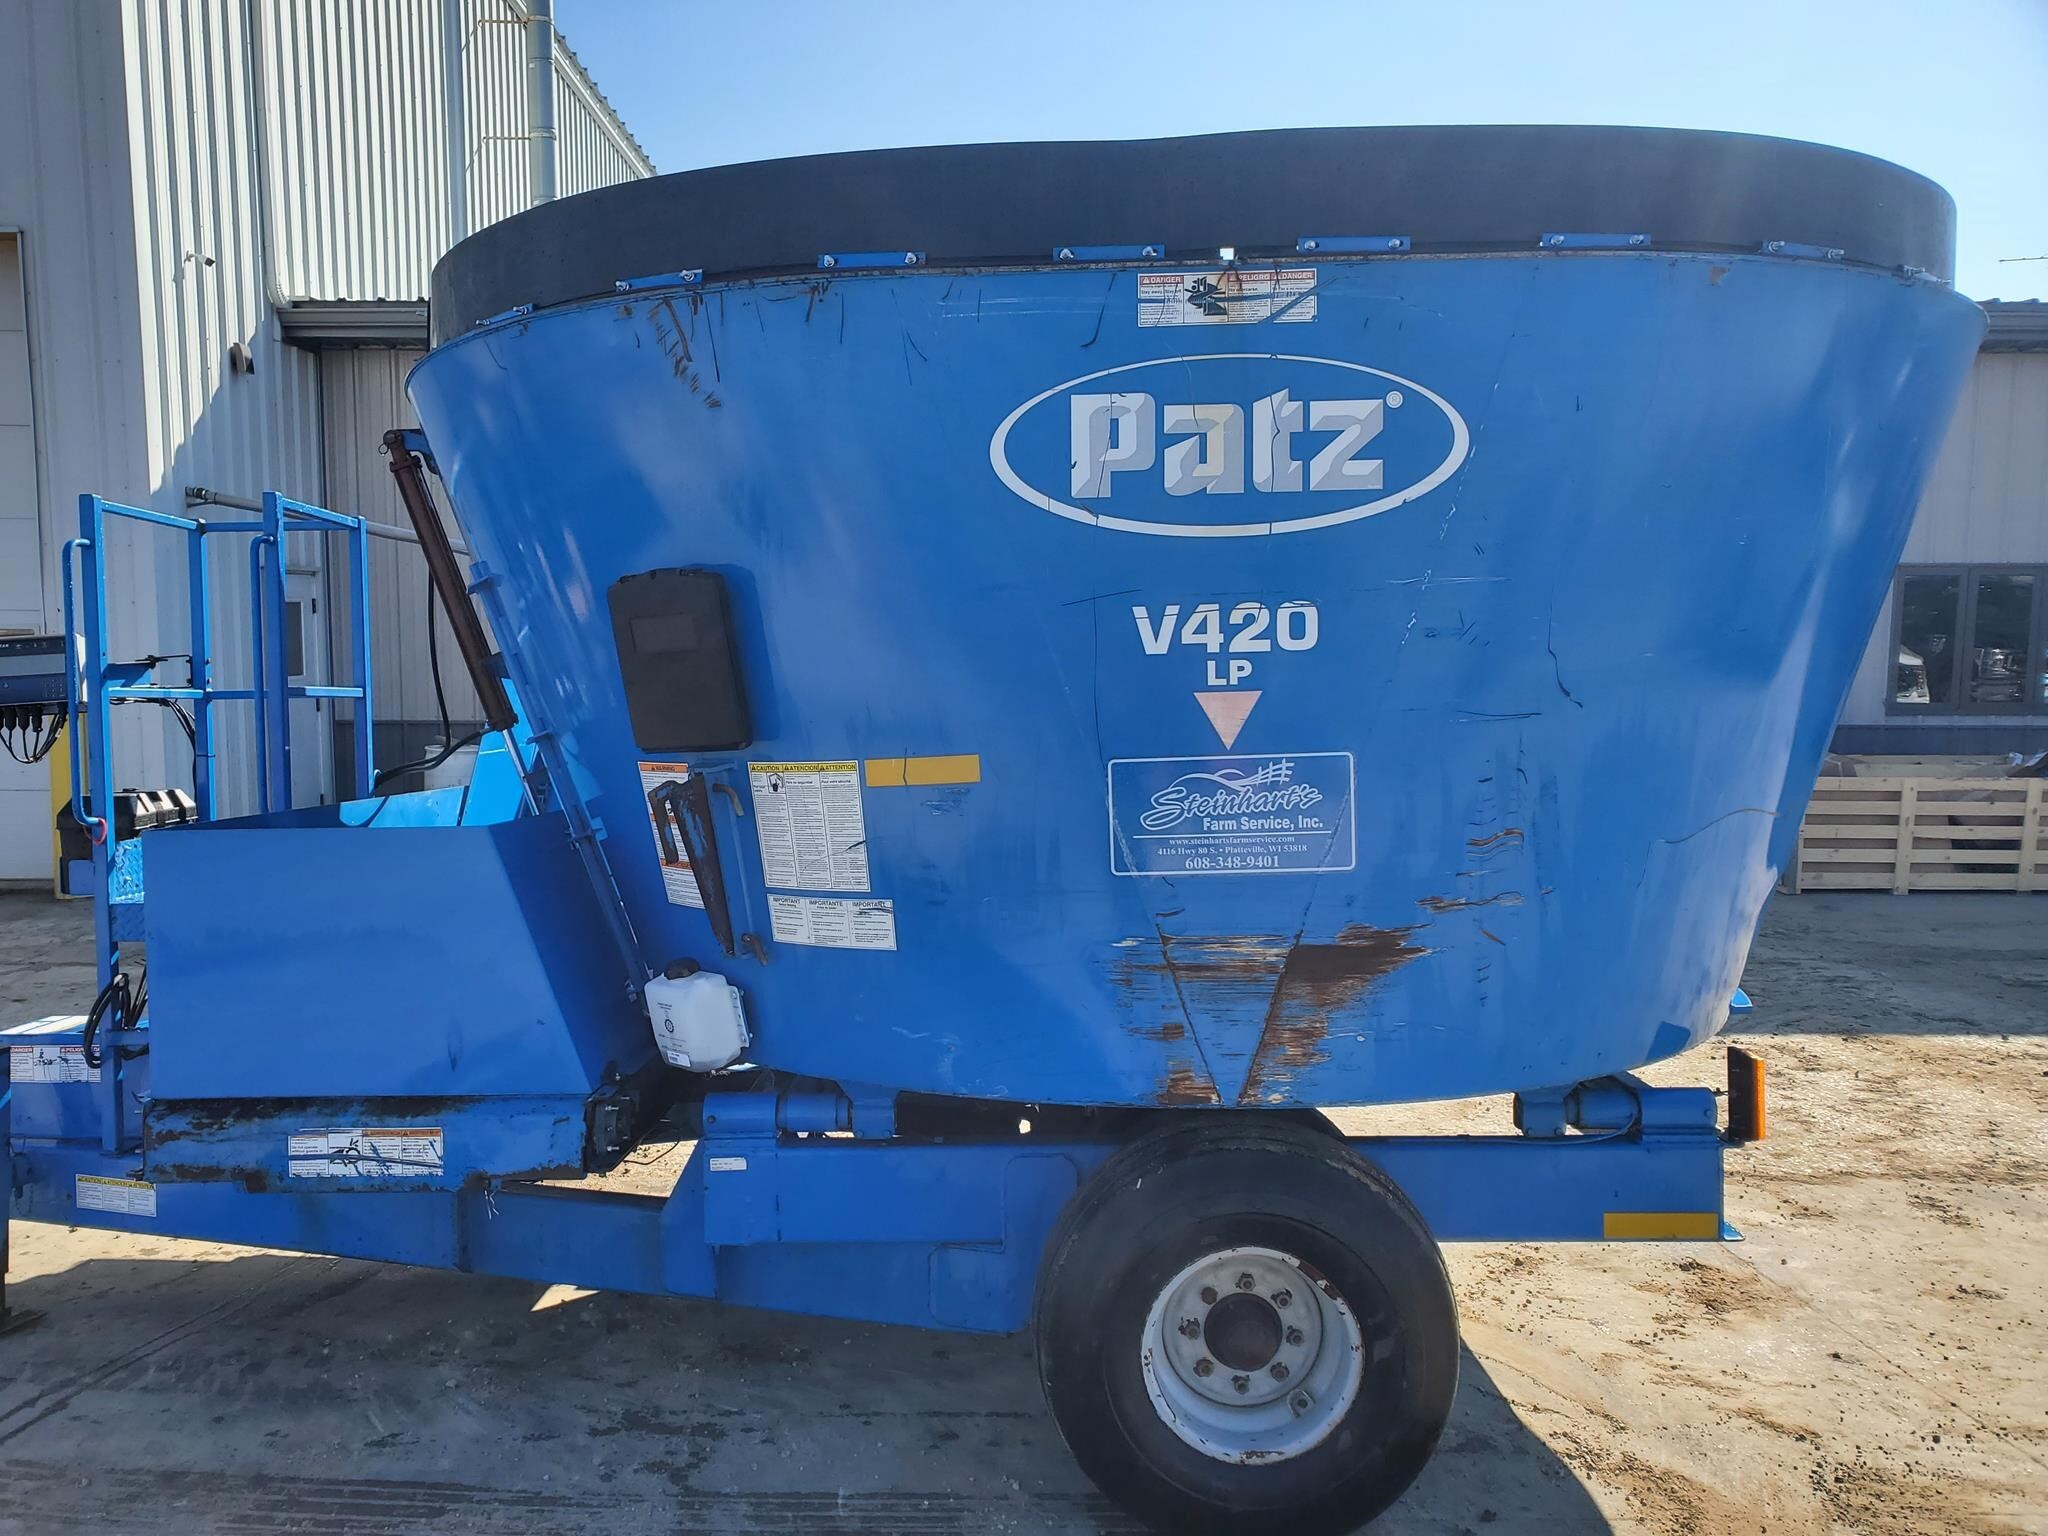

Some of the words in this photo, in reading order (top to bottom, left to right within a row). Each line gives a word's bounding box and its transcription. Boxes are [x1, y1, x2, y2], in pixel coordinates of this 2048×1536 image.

[1150, 276, 1181, 284] DANGER
[1282, 271, 1313, 279] DANGER
[1070, 388, 1384, 499] Patz
[1131, 601, 1320, 656] V420
[1206, 659, 1253, 687] LP
[1203, 817, 1237, 831] Farm
[1240, 815, 1295, 832] Service,
[1298, 814, 1324, 829] Inc.
[1169, 836, 1295, 846] www.steinhartsfarmservice.com
[1157, 847, 1176, 855] 4116
[1177, 847, 1196, 856] Hwy
[1225, 845, 1267, 855] Platteville,
[1268, 845, 1282, 853] WI
[1283, 844, 1308, 853] 53818
[1185, 854, 1280, 870] 608-348-9401
